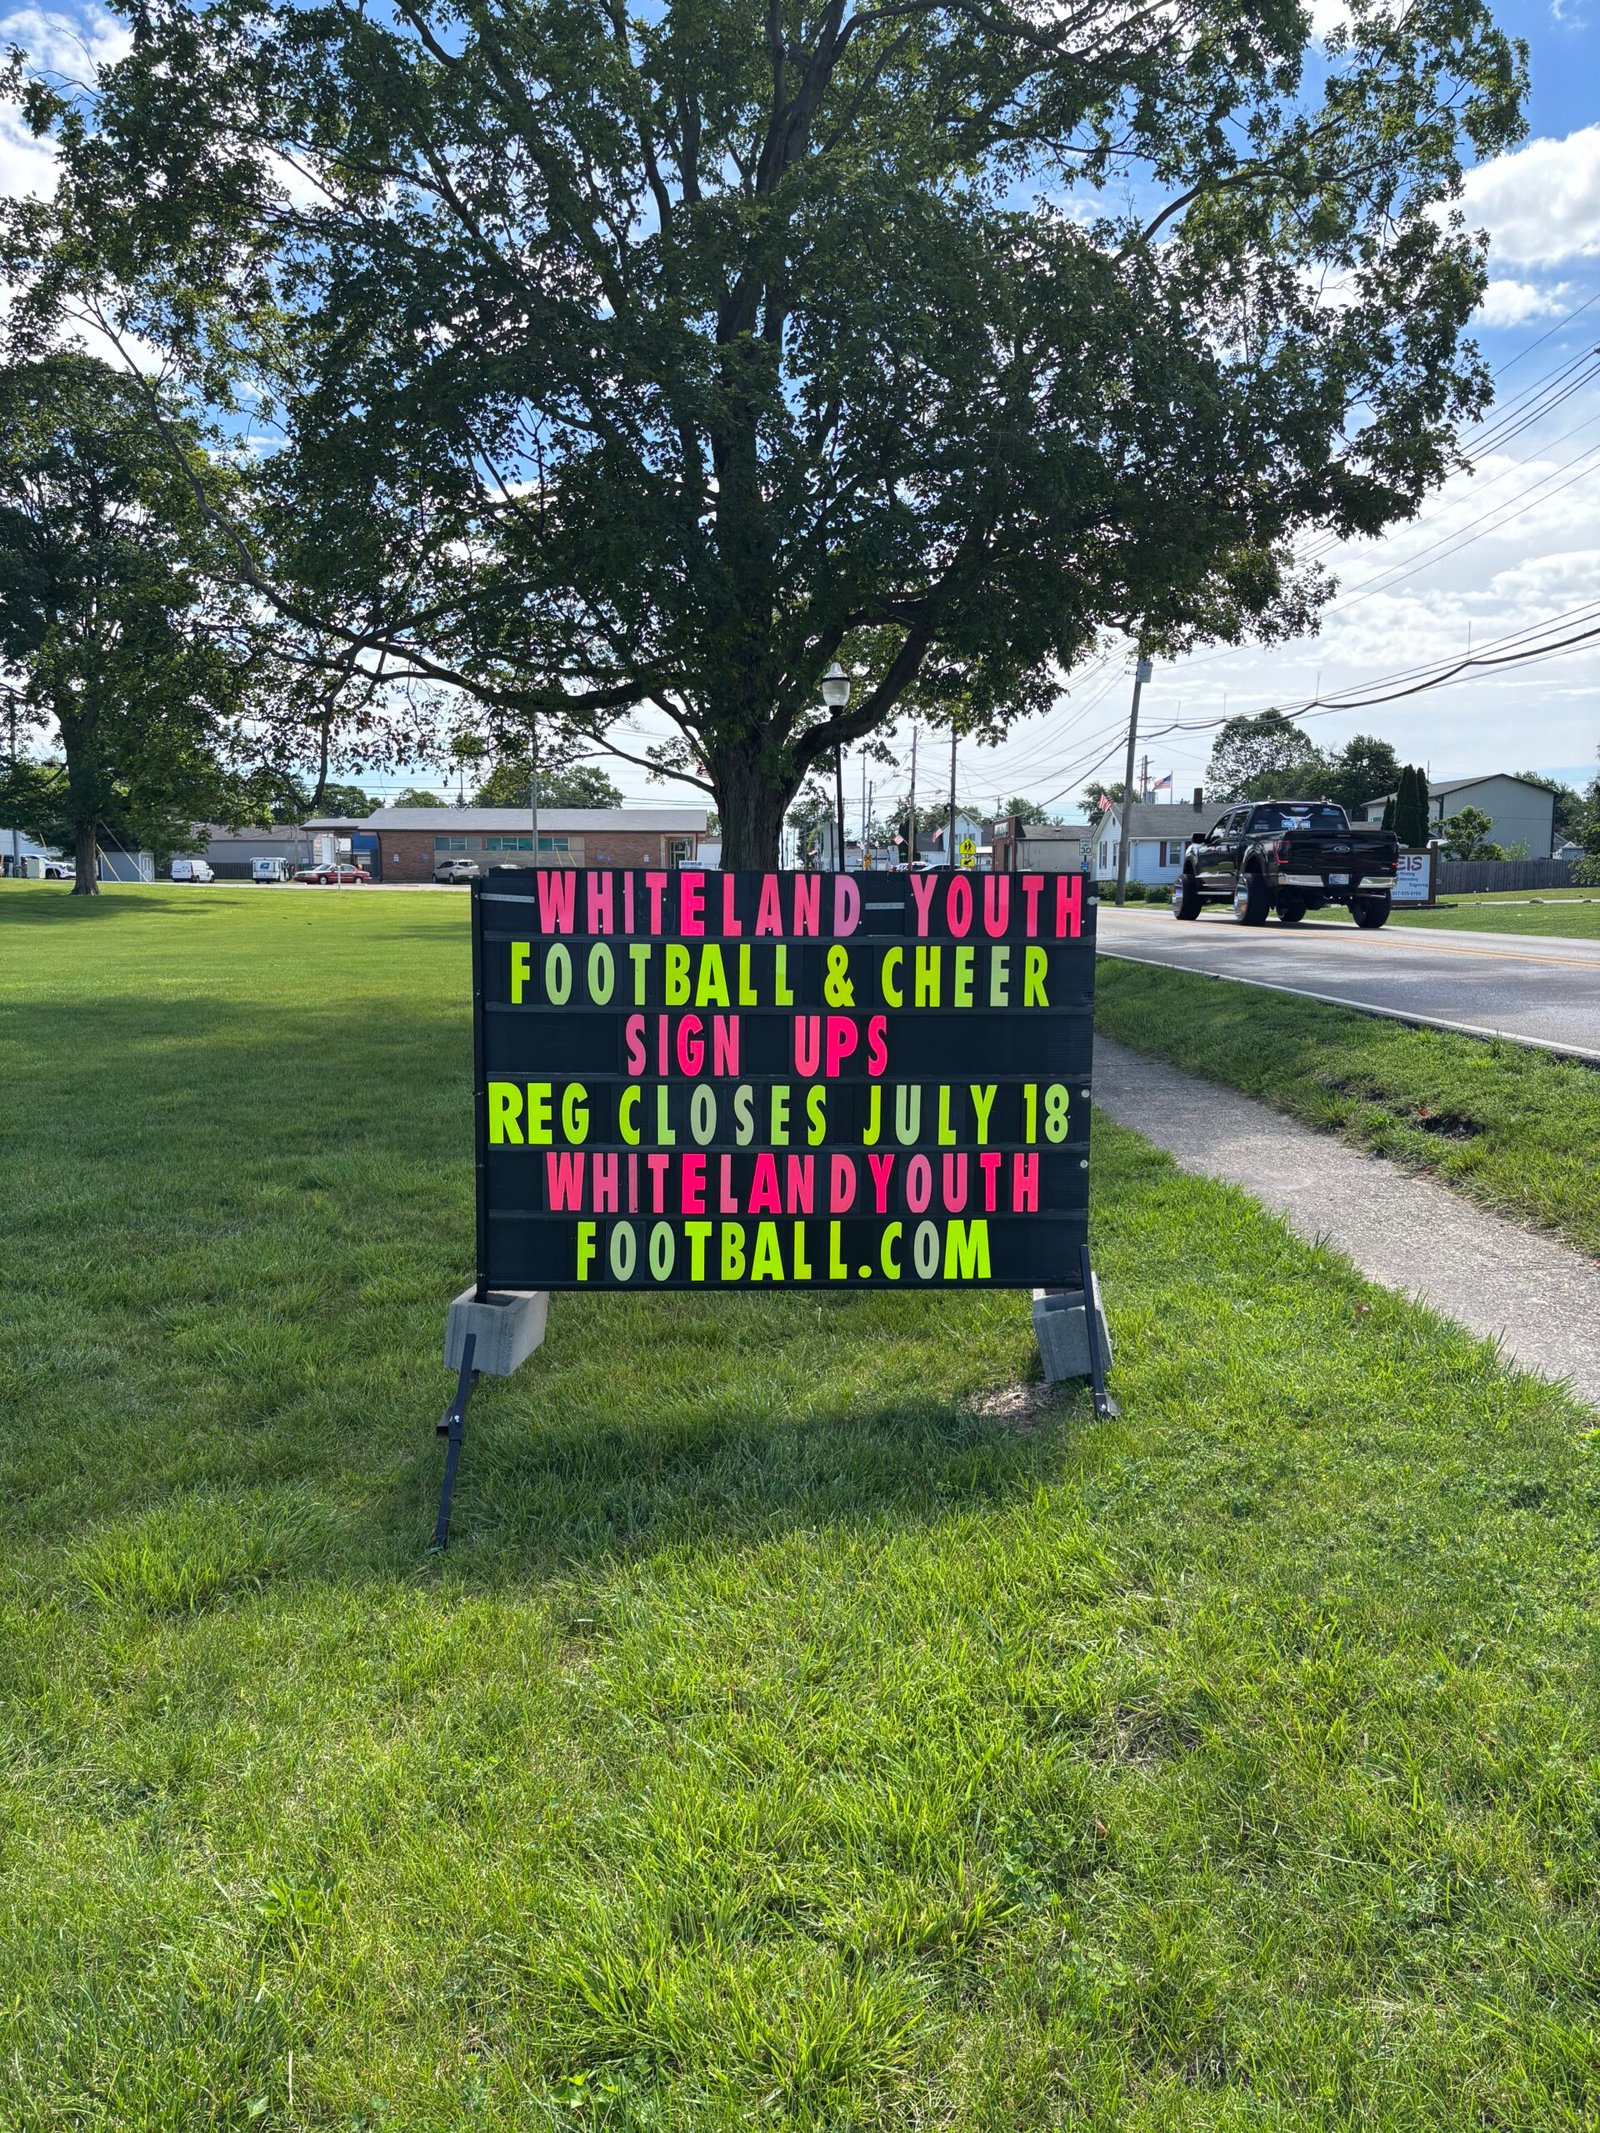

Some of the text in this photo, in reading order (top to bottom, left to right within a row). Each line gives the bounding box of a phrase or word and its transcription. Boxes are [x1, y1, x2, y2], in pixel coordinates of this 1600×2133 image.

[537, 871, 1082, 937] WHITELAND YOUTH
[511, 942, 1049, 1007] FOOTBALL & CHEER
[626, 1014, 888, 1077] SIGN UPS
[488, 1082, 1069, 1146] REG CLOSES JULY 18
[546, 1152, 1039, 1214] WHITELANDYOUTH
[577, 1219, 991, 1281] FOOTBALL.COM
